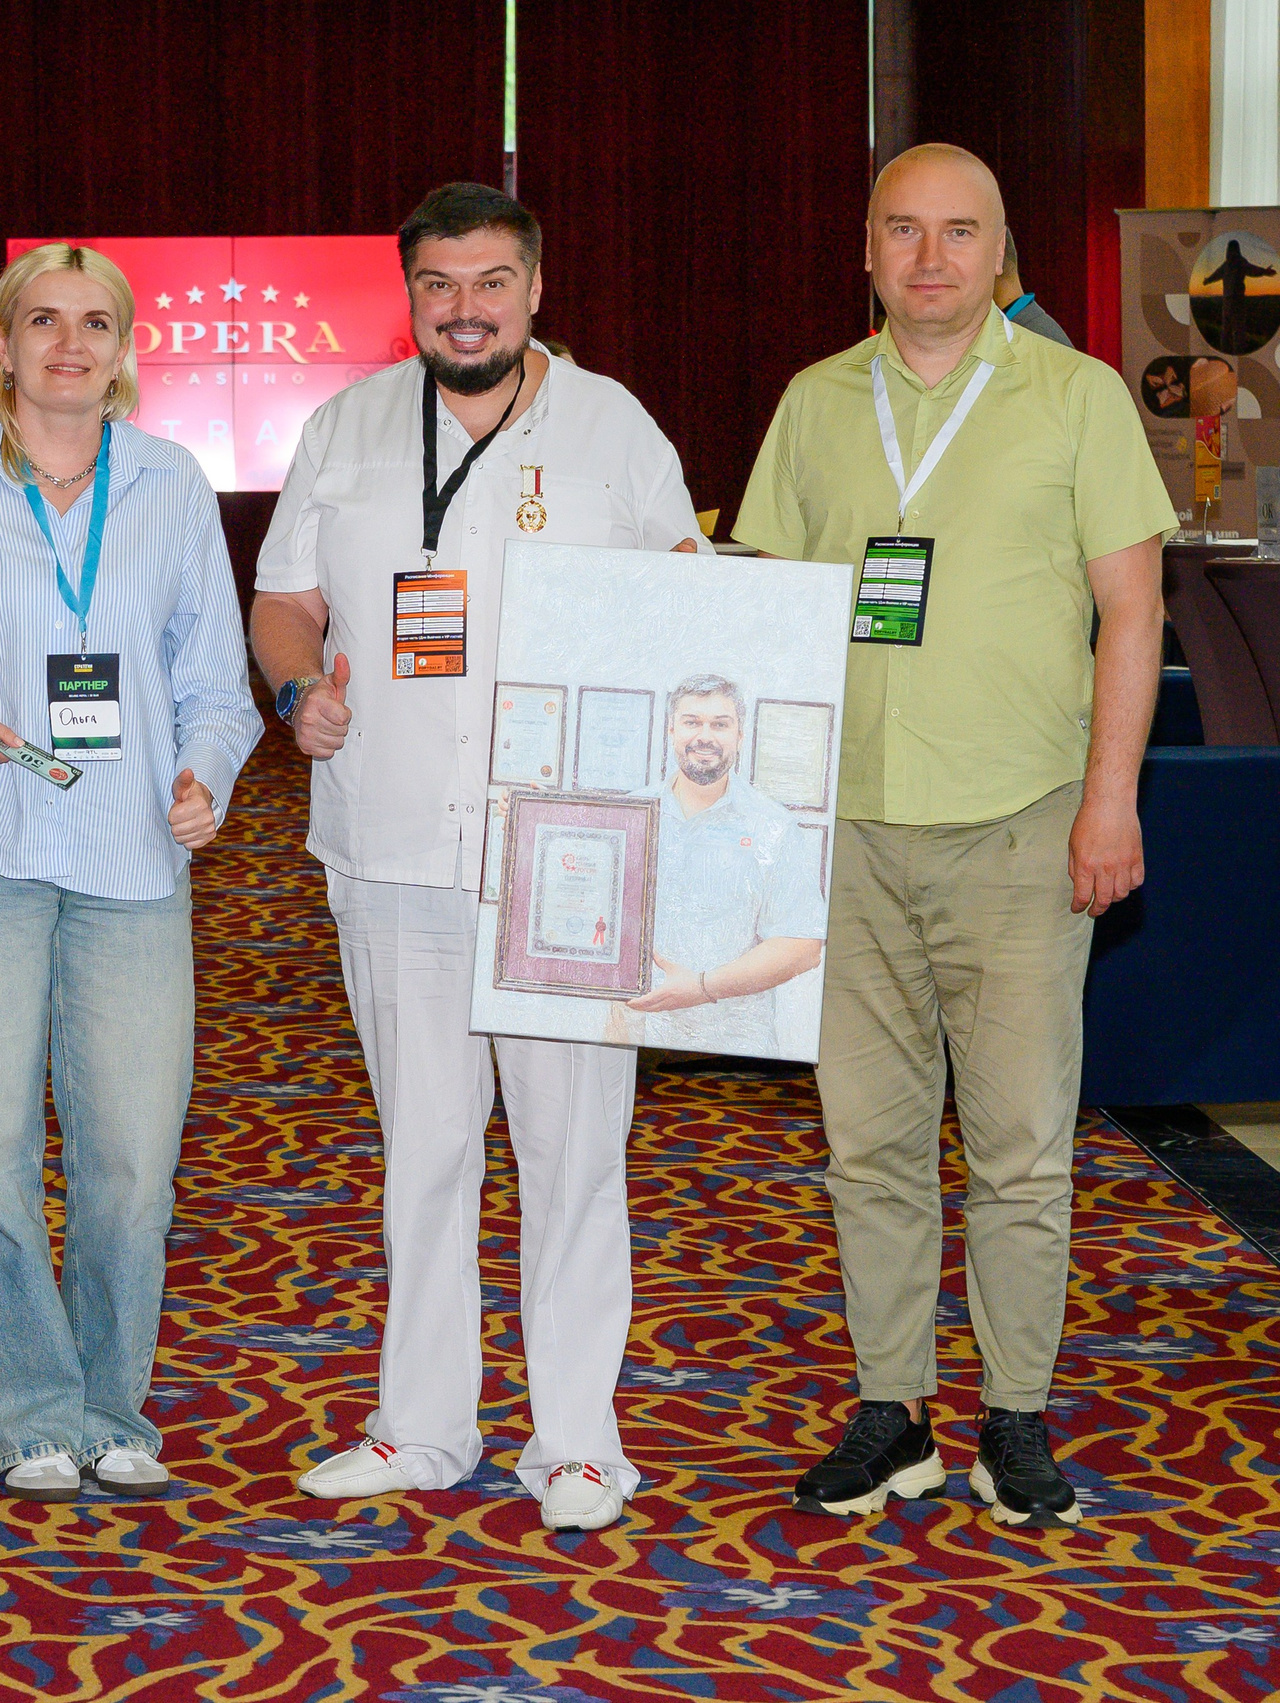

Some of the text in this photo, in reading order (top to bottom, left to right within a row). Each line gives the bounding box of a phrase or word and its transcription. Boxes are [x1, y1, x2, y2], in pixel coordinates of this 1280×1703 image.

[132, 320, 346, 364] OPERA
[162, 372, 305, 385] CASINO
[59, 680, 109, 691] ПАРТНЕР
[59, 707, 98, 726] Ольга
